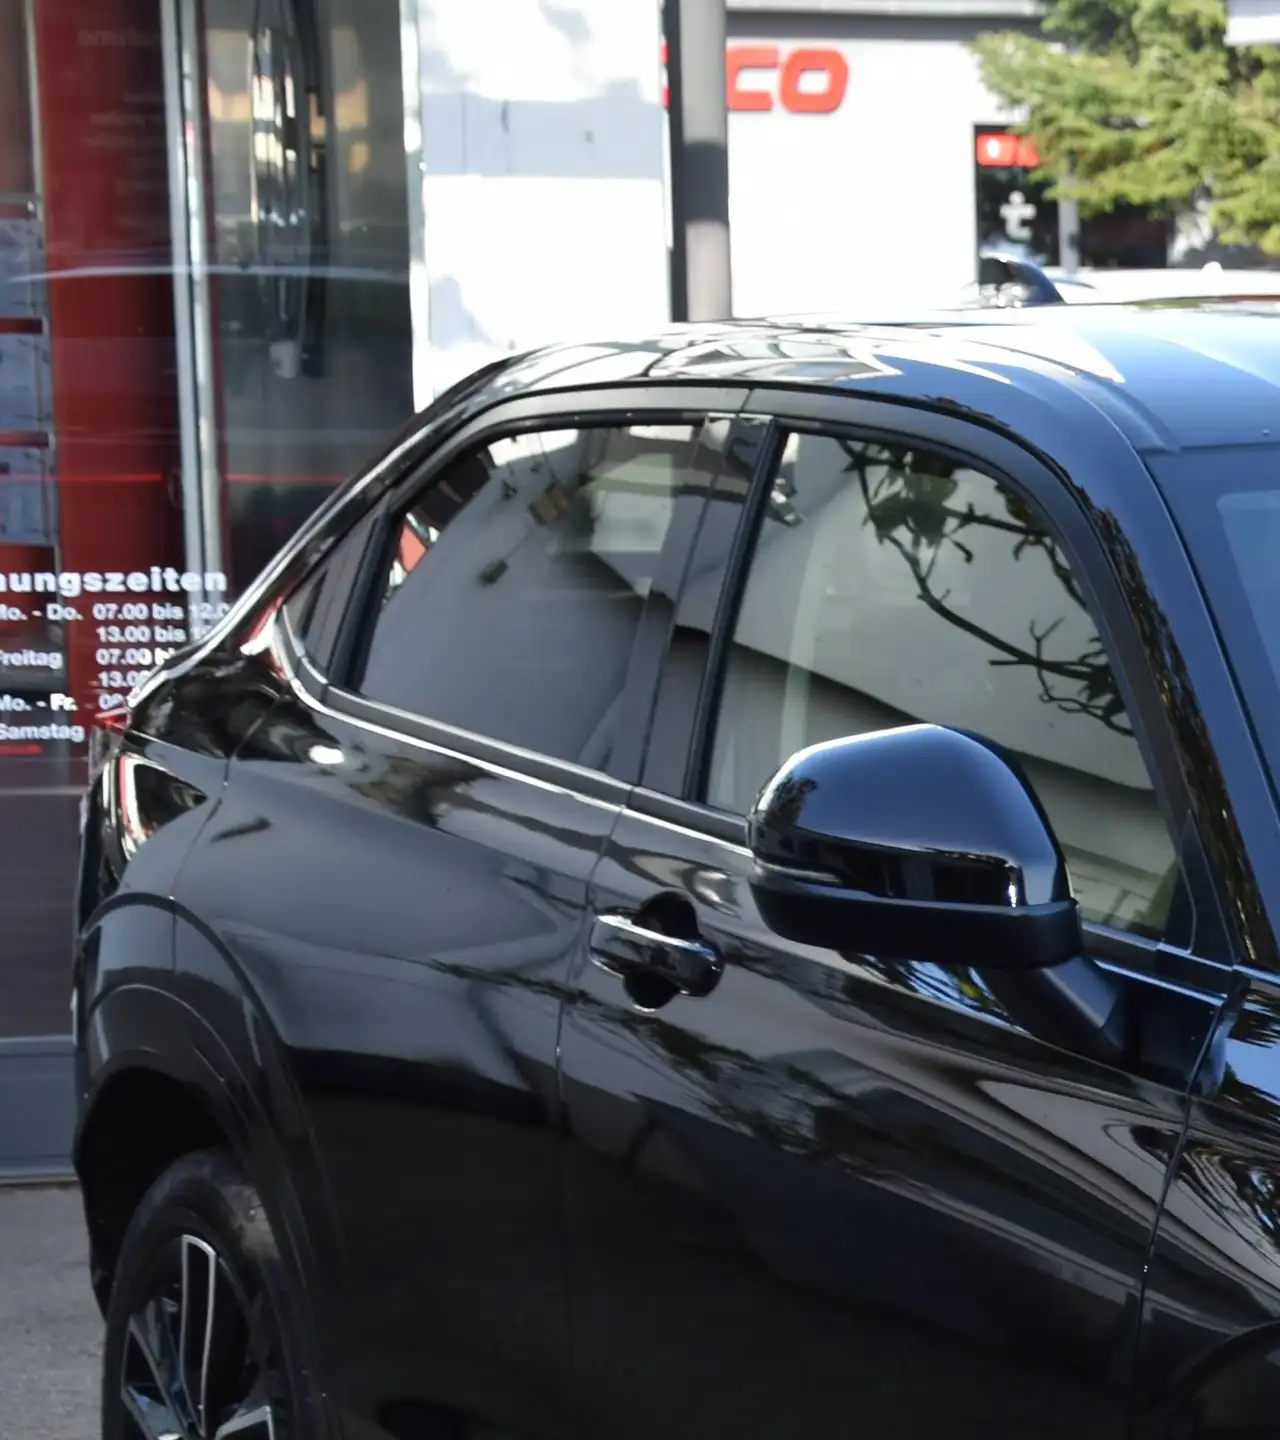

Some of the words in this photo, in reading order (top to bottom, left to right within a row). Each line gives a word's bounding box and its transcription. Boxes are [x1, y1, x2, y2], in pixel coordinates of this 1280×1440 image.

[661, 44, 849, 113] CO
[46, 603, 84, 621] Do.
[92, 602, 149, 621] 07.00
[152, 602, 185, 620] bis
[96, 625, 151, 643] 13.00
[154, 625, 187, 643] bis
[96, 648, 153, 666] 07.00
[49, 692, 79, 711] Fr.
